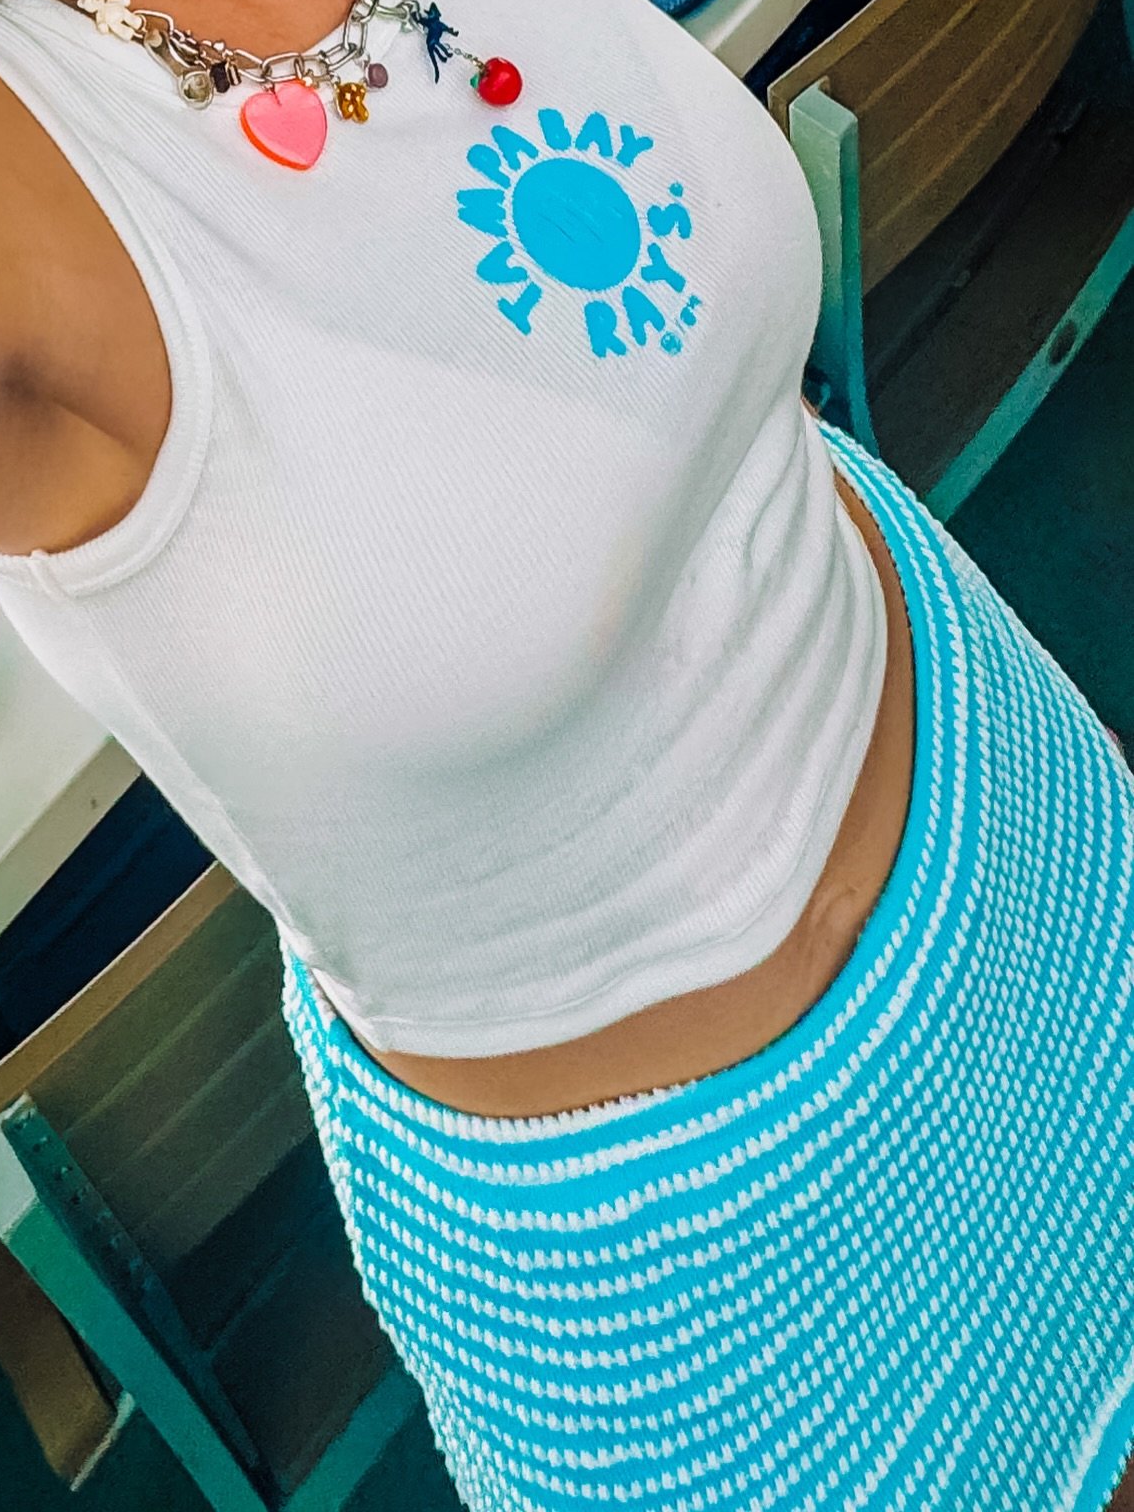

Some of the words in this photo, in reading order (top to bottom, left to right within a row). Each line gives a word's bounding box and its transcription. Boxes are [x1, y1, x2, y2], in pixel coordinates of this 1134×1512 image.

[456, 124, 543, 336] TAMPA
[537, 108, 654, 168] BAY
[584, 202, 692, 358] RAYS
